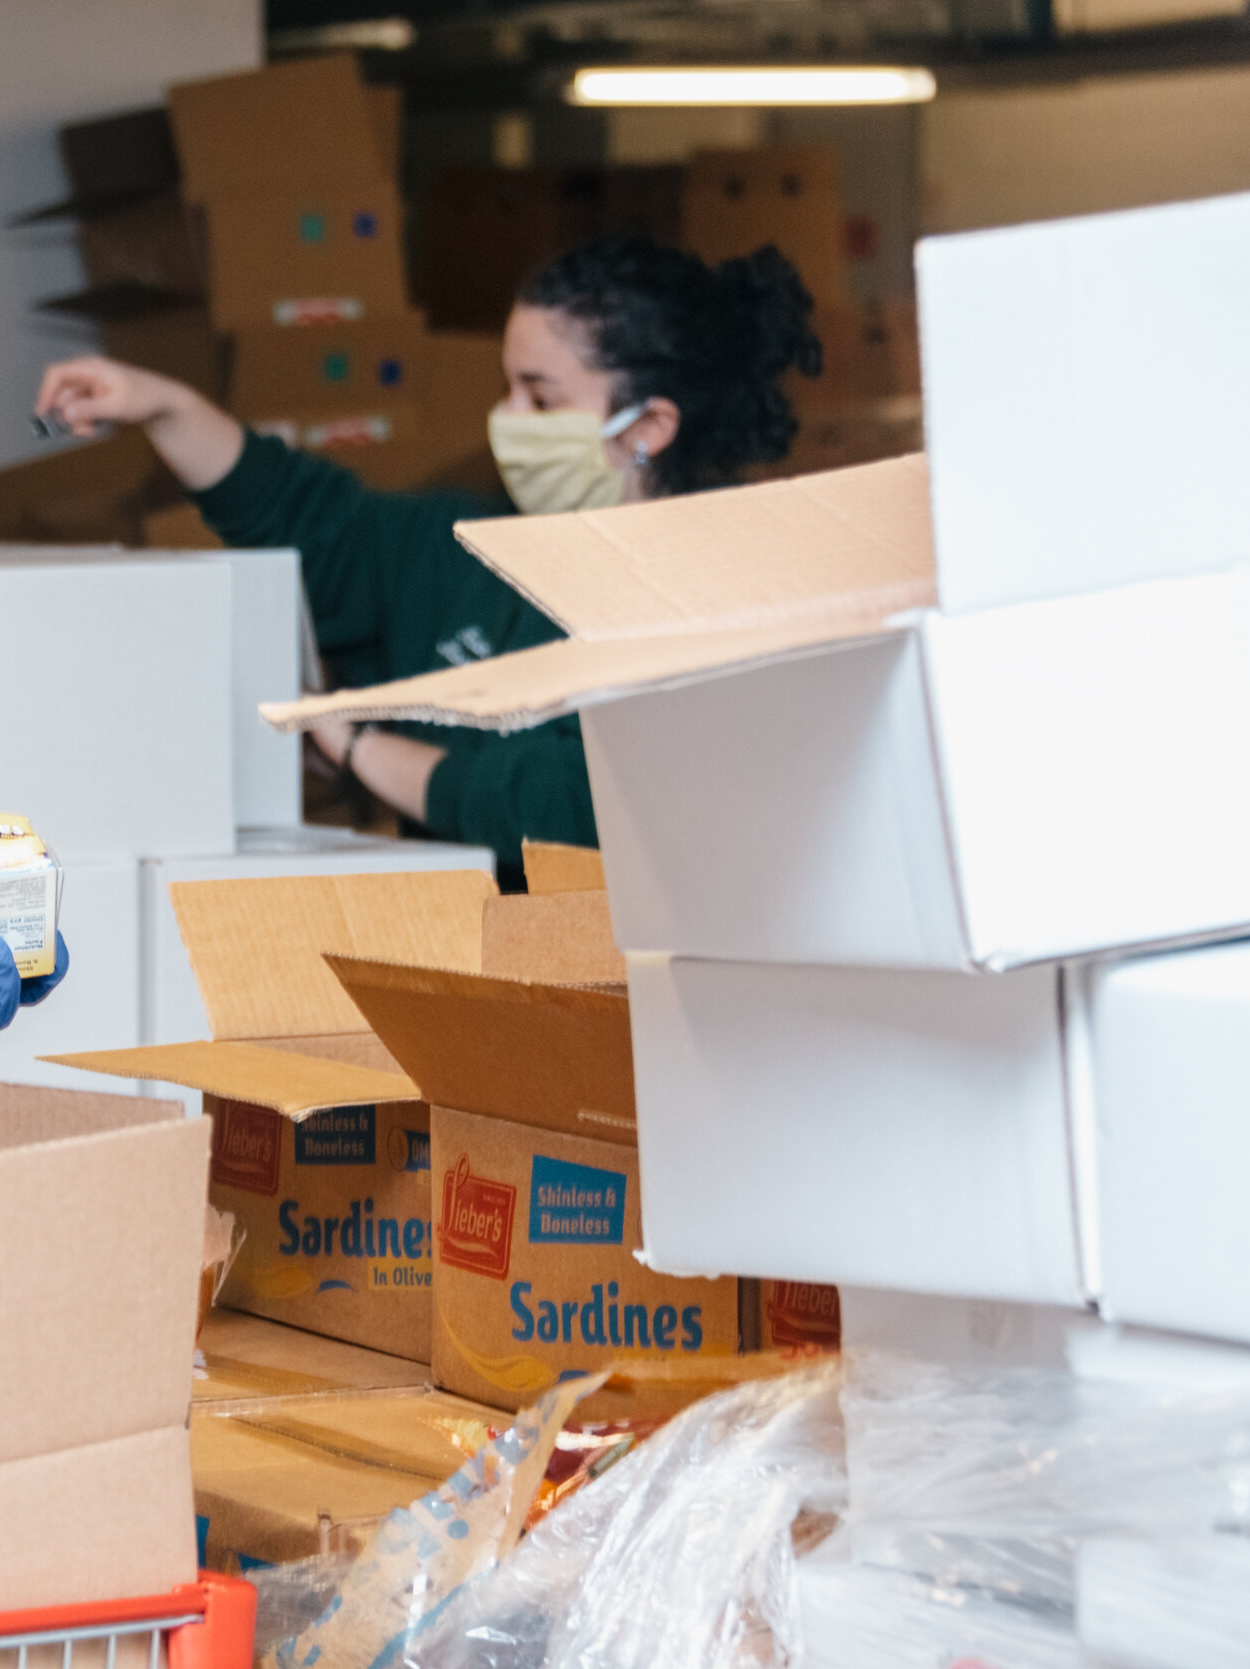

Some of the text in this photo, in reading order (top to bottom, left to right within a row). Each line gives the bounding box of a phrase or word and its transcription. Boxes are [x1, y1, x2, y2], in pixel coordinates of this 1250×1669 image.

[305, 1137, 366, 1158] Boneless
[605, 1187, 617, 1209] &
[278, 1197, 432, 1260] Sardine
[540, 1212, 611, 1236] Boneless
[373, 1266, 432, 1286] In Olive
[510, 1280, 704, 1351] Sardines
